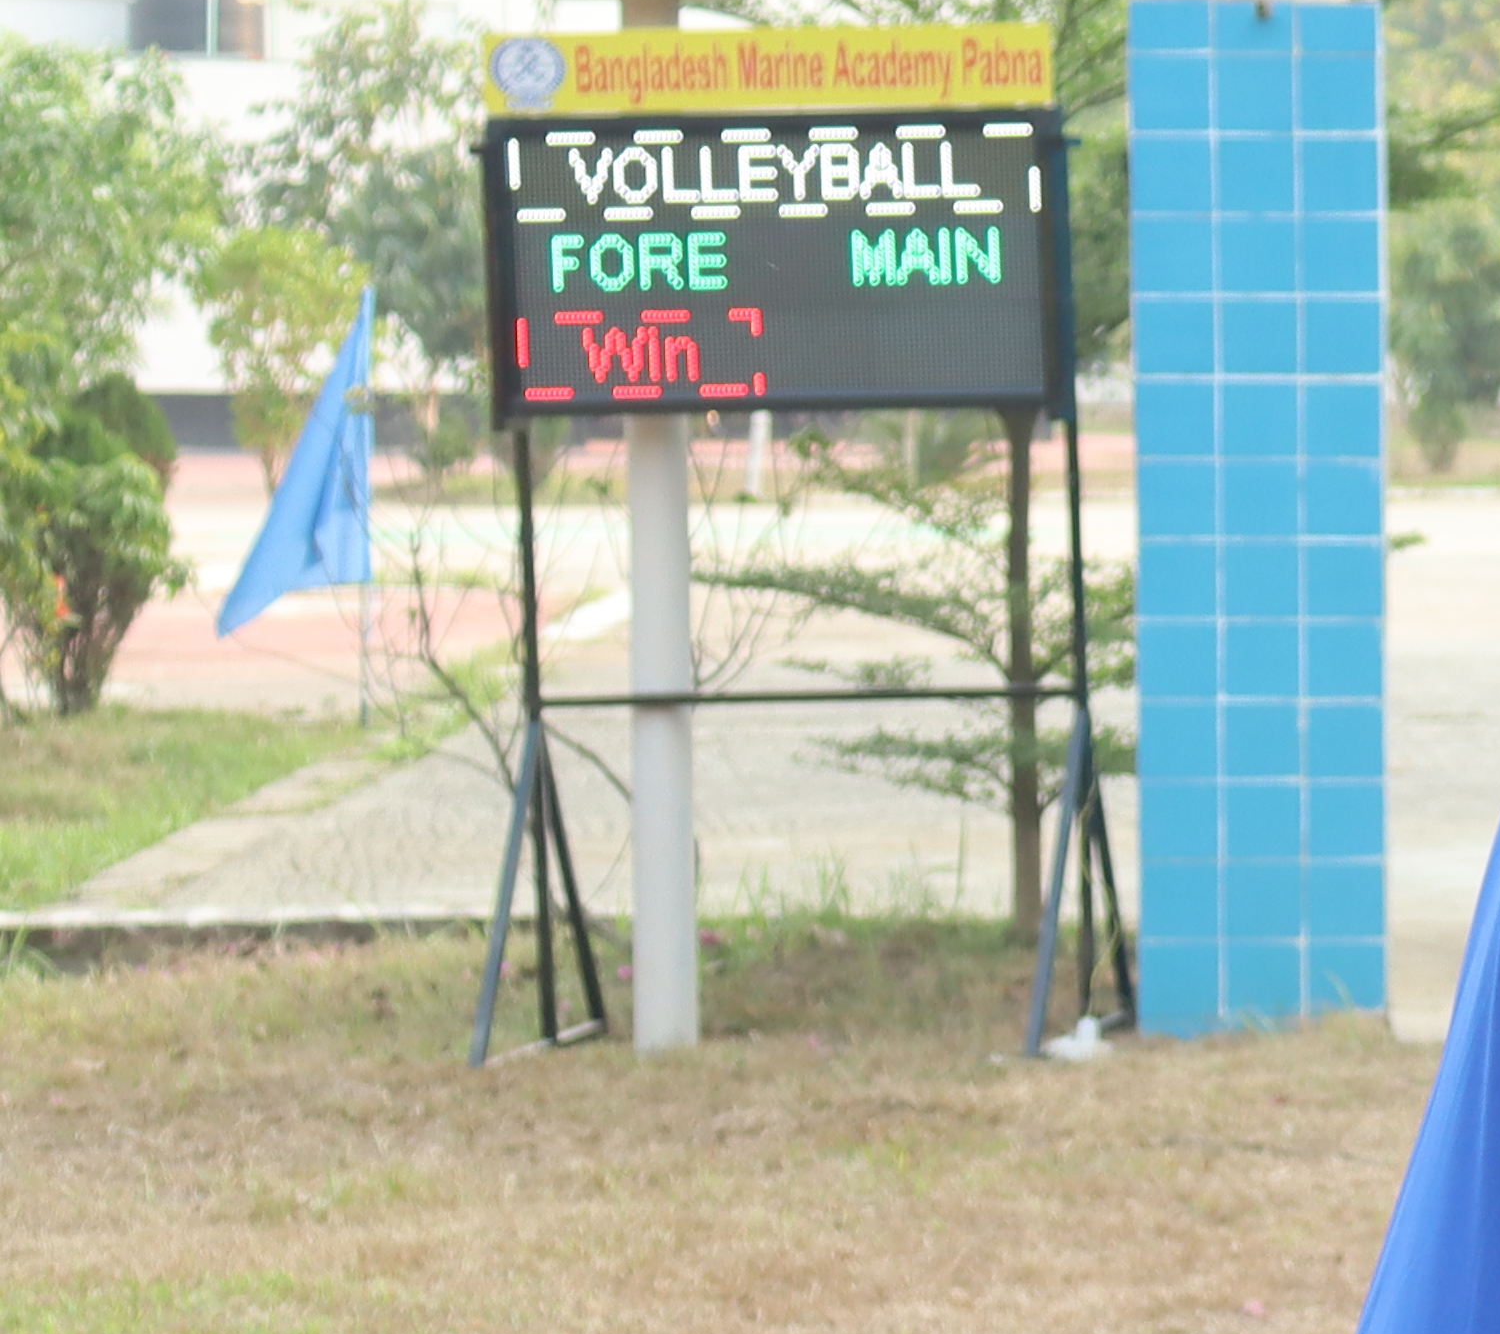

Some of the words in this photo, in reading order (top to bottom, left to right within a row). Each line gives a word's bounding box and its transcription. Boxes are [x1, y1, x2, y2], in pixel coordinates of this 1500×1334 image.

[574, 45, 729, 104] Bangladesh
[737, 43, 826, 91] Marine
[833, 38, 956, 99] Academy
[961, 36, 1044, 88] Pabna
[568, 141, 981, 204] VOLLEYBALL
[550, 231, 728, 292] FORE
[850, 225, 1002, 287] MAIN
[582, 326, 700, 383] Win
